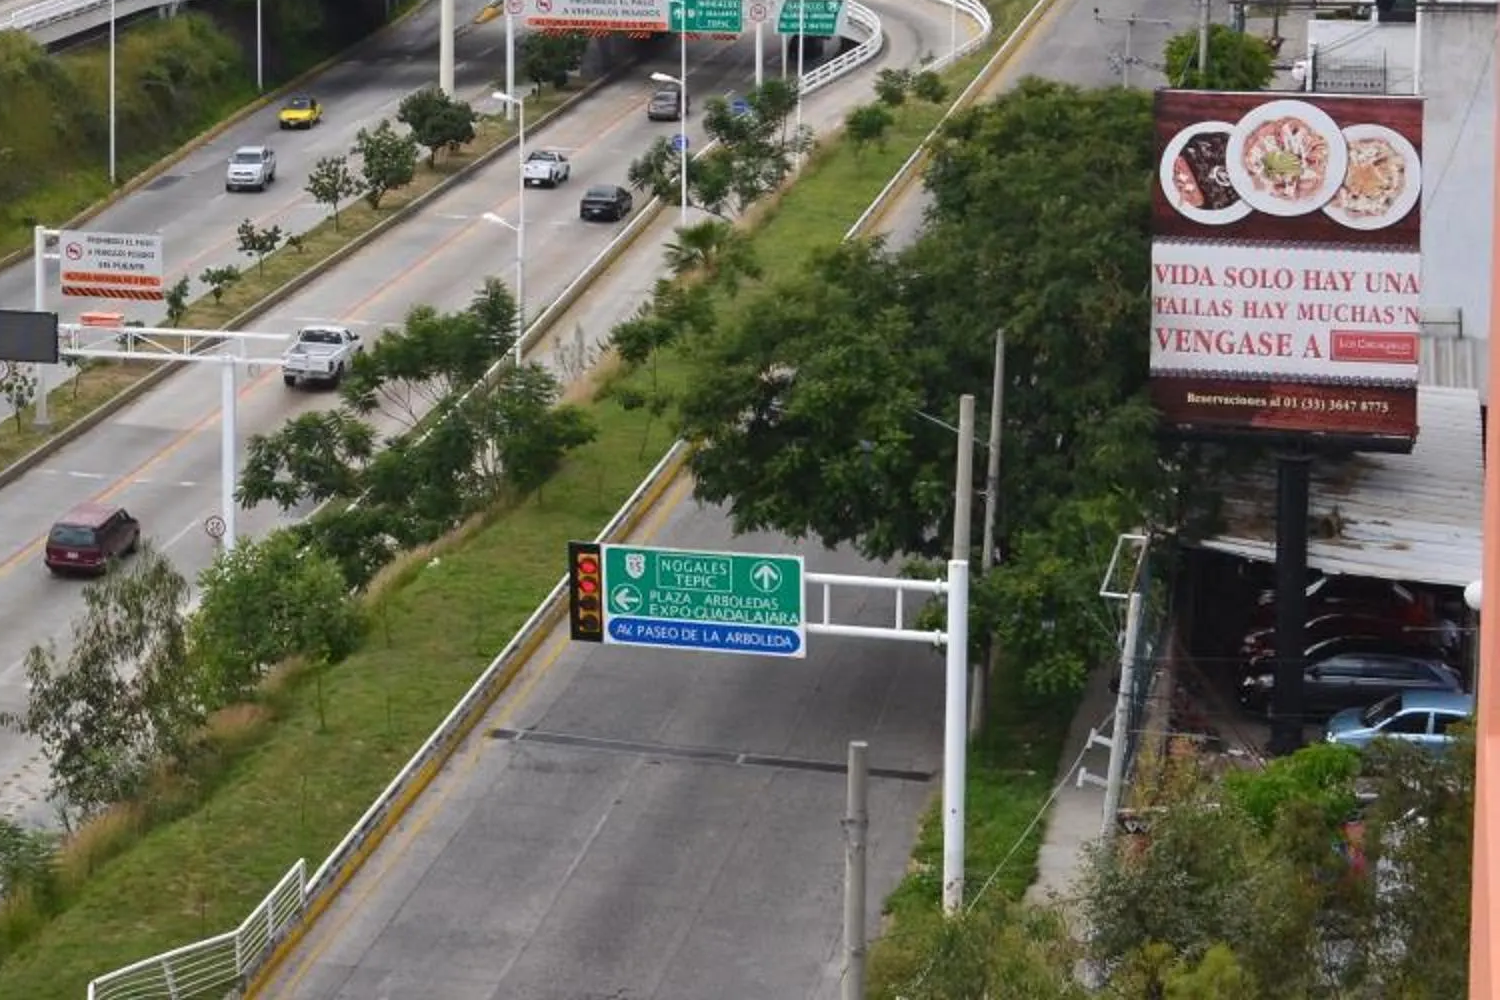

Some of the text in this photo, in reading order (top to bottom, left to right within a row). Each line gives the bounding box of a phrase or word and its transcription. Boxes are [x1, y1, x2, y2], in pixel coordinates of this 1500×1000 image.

[1153, 263, 1420, 295] VIDA SOLO HAY UNA
[1154, 295, 1233, 317] TALLAS
[1243, 299, 1289, 320] HAY
[1154, 326, 1324, 359] VENGASE A
[1187, 391, 1266, 407] Reservaciones
[1269, 393, 1281, 407] al
[1284, 397, 1298, 409] 01
[1301, 397, 1325, 412] (33)
[661, 559, 727, 576] NOGALES
[673, 573, 717, 589] TEPIC
[649, 590, 780, 611] PLAZA ARBOLEDAS
[649, 603, 799, 625] EXPO GUADALAJARA
[637, 624, 679, 639] PASEO
[681, 627, 698, 641] DE
[703, 629, 721, 643] LA
[724, 630, 793, 649] ARBOLEDA
